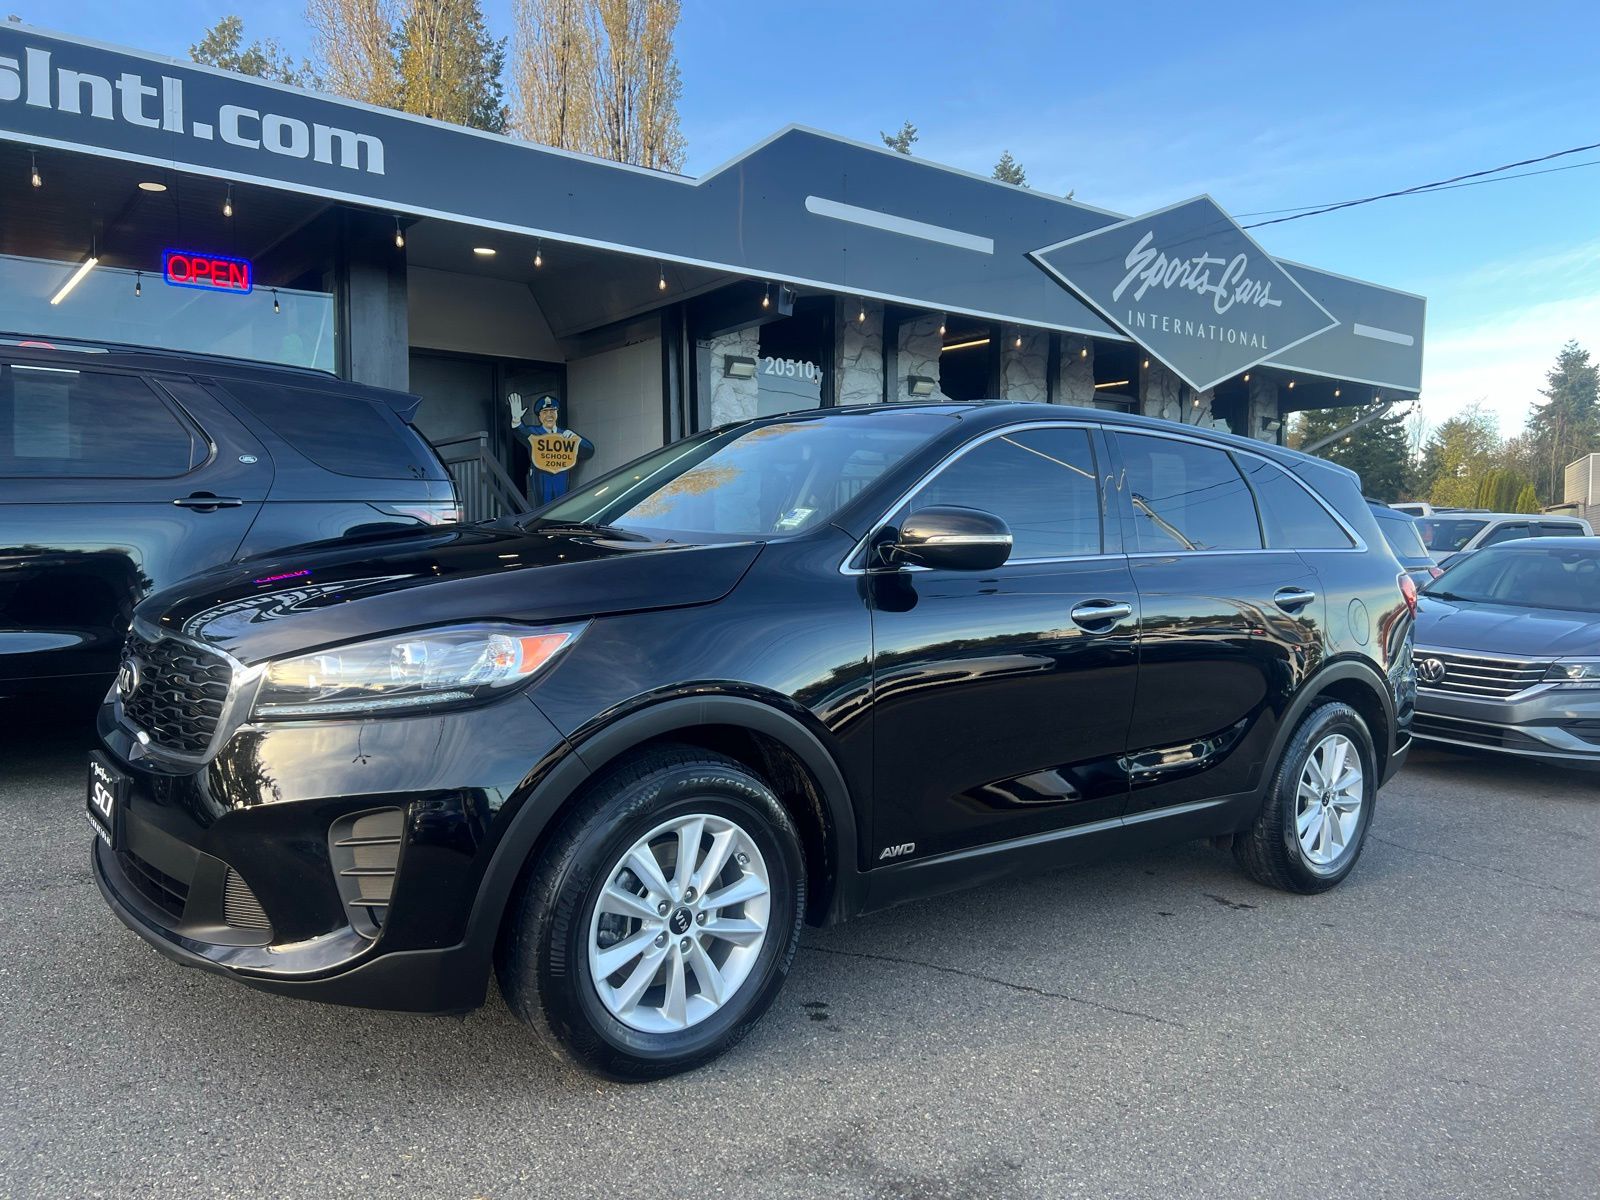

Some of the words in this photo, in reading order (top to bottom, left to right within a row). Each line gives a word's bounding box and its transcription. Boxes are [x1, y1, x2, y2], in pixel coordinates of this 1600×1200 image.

[168, 255, 248, 290] OPEN
[1112, 230, 1226, 303] Sports
[1213, 252, 1283, 315] Cars
[1128, 309, 1268, 350] INTERNATIONAL
[764, 356, 815, 379] 20510
[537, 439, 576, 453] SLOW
[540, 452, 573, 461] SCHOOL
[545, 460, 568, 468] ZONE
[879, 842, 916, 860] AWD
